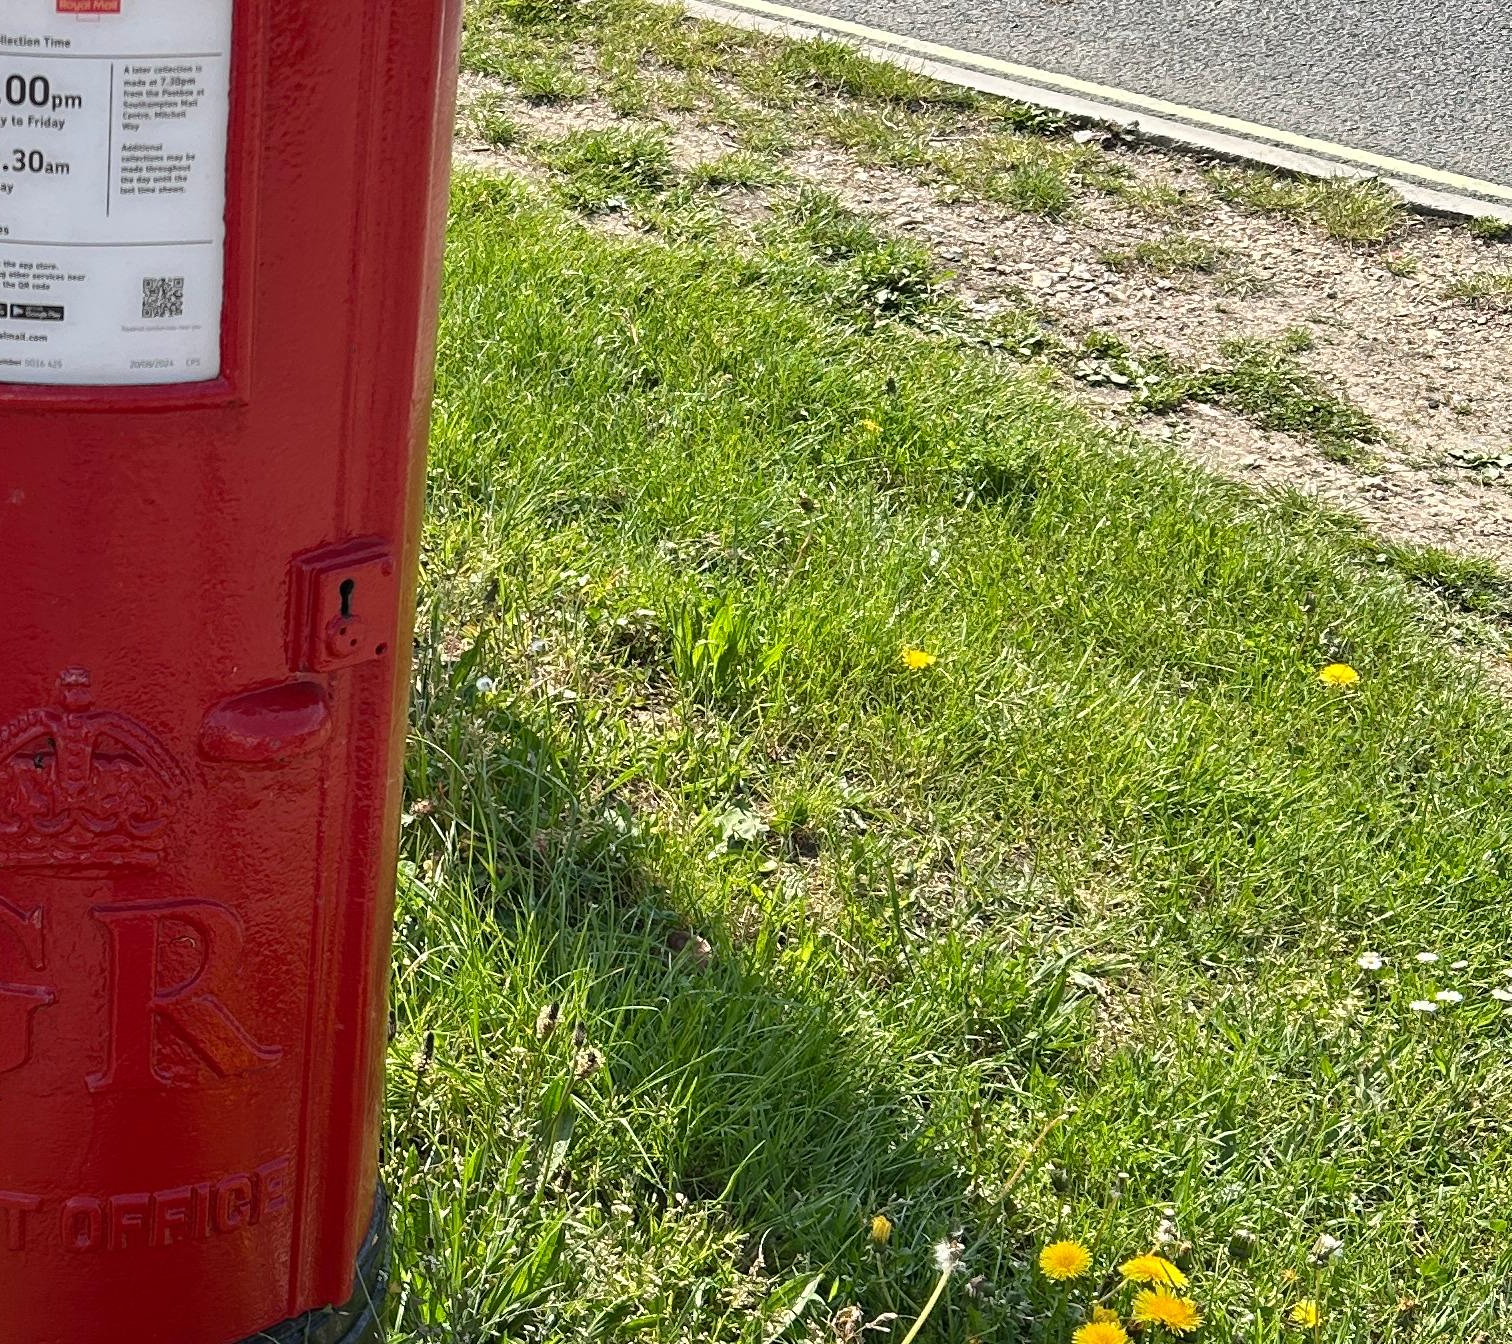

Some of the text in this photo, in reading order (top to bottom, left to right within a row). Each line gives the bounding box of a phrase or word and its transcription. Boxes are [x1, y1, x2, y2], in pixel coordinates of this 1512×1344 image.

[44, 35, 71, 48] Time
[12, 115, 24, 127] to
[28, 115, 65, 130] Friday
[62, 1155, 291, 1253] OFFICE
